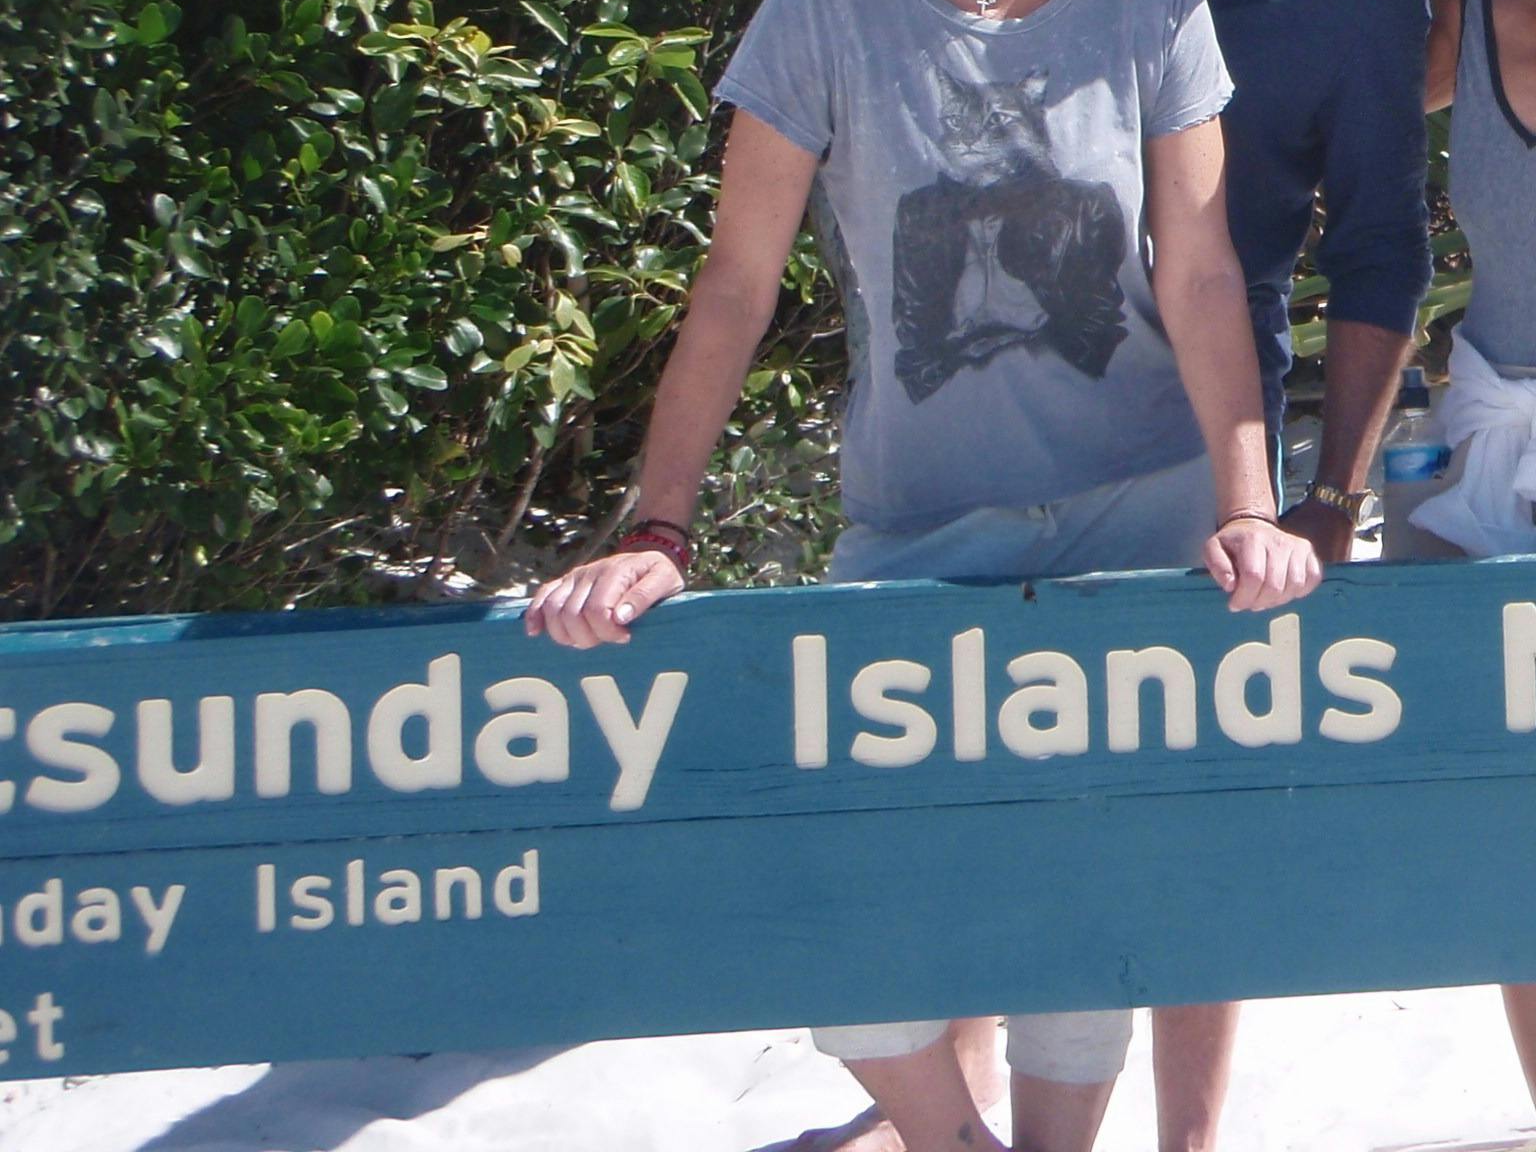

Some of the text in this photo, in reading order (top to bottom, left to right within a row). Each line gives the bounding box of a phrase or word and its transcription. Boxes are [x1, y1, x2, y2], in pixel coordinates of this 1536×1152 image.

[793, 613, 1402, 769] Islands
[0, 849, 540, 955] day Island
